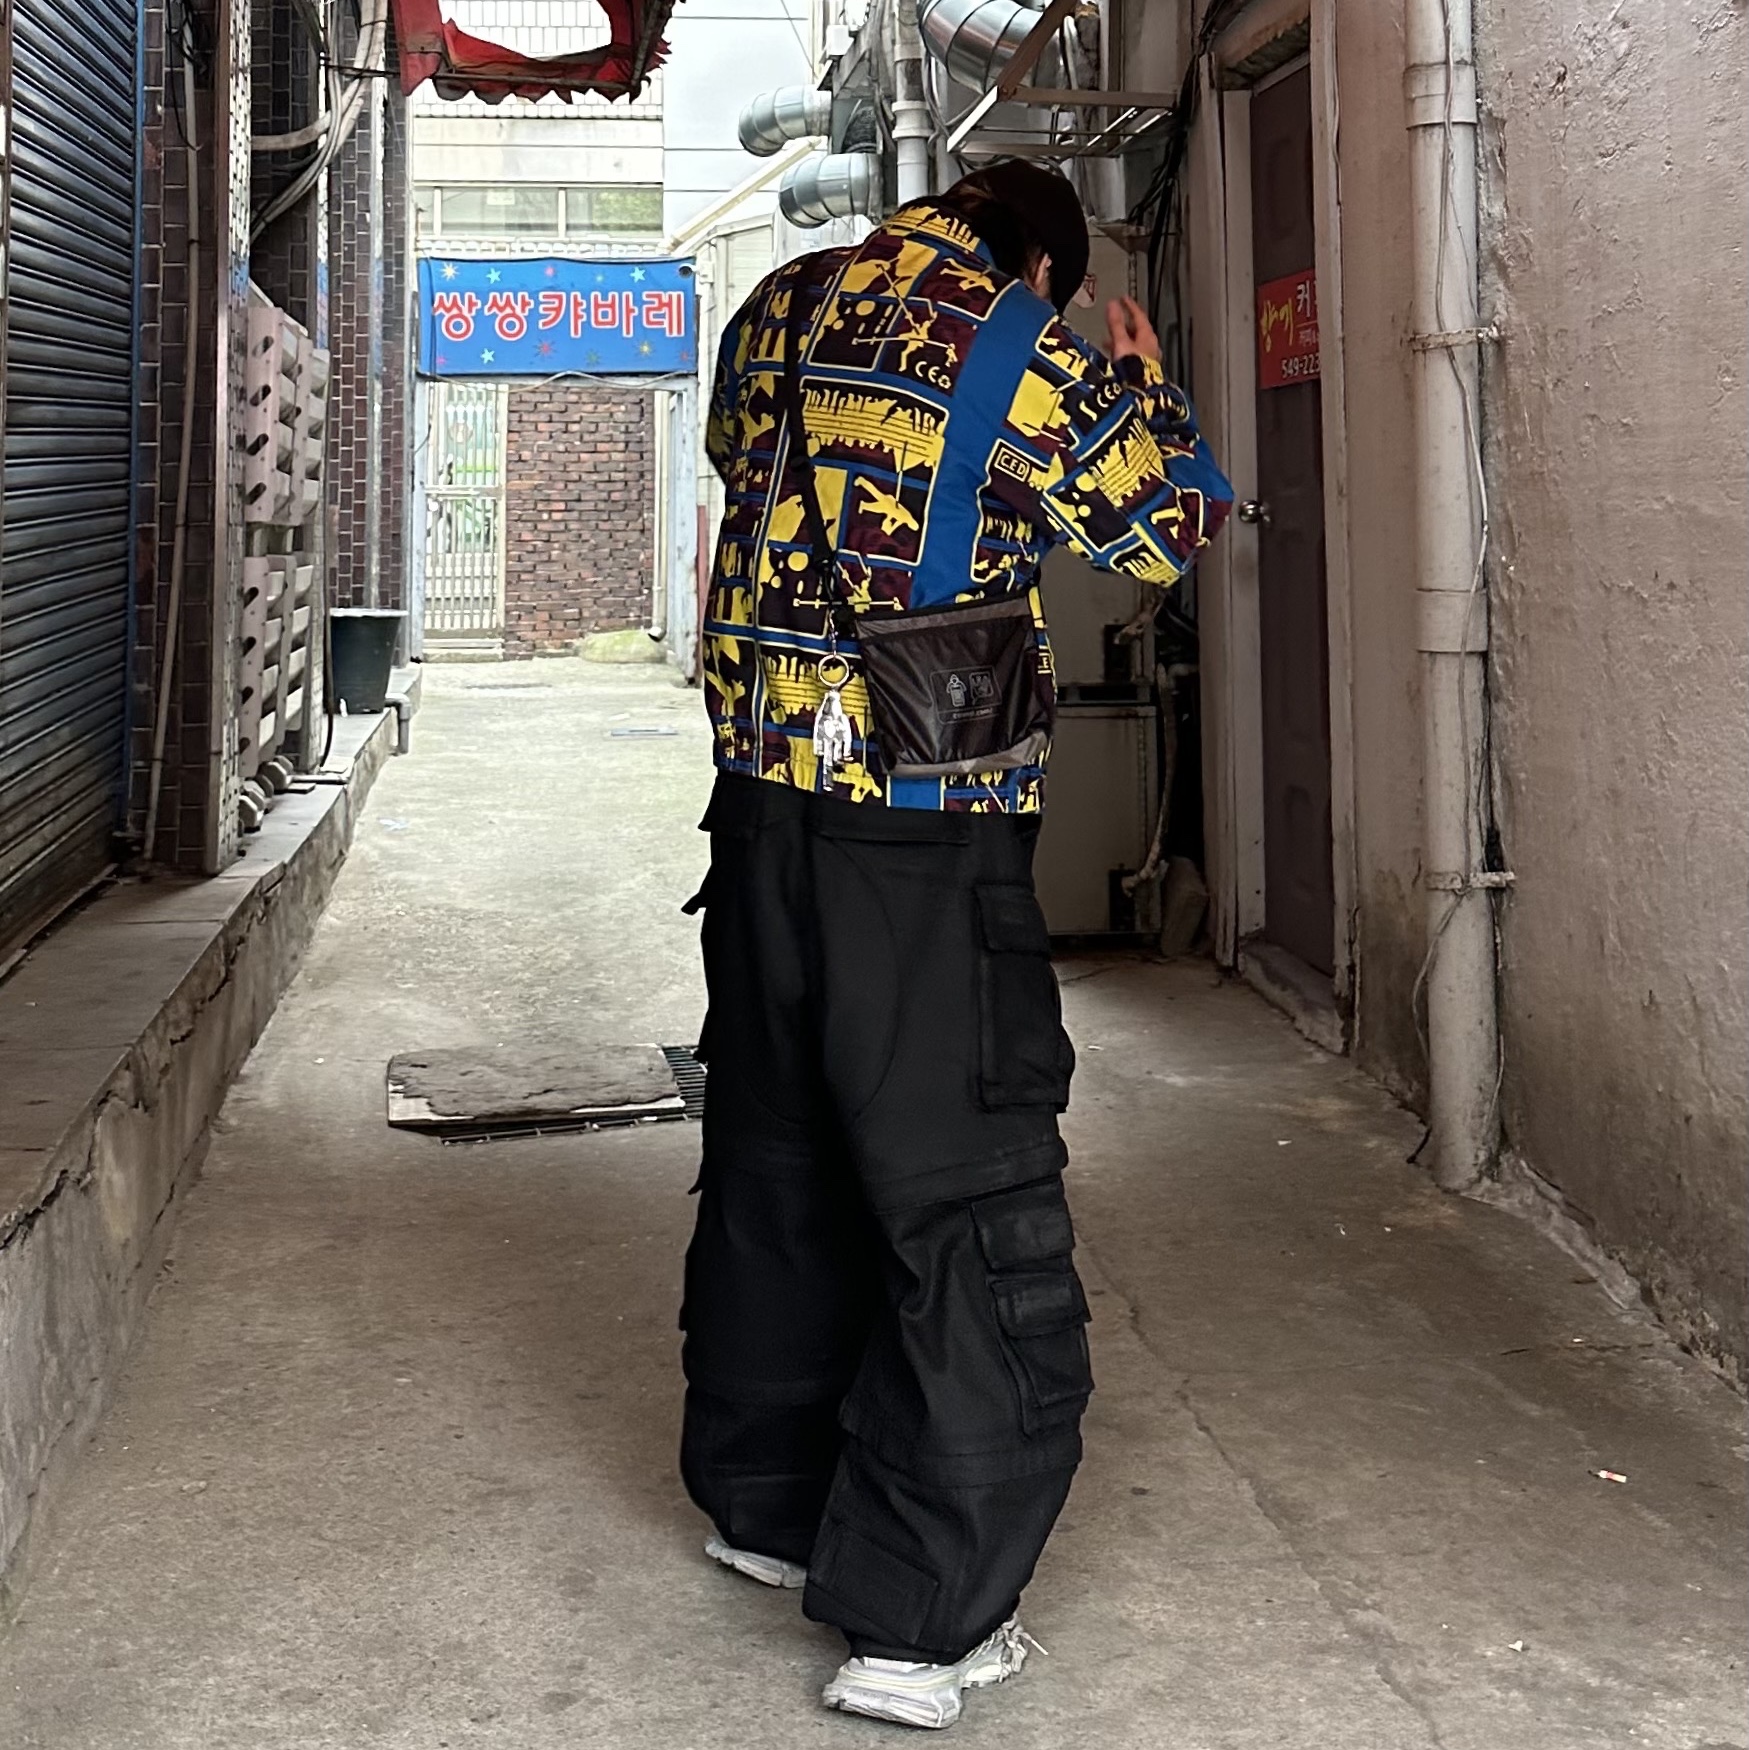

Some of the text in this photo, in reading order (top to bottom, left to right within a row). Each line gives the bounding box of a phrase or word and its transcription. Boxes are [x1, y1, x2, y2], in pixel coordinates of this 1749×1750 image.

[1297, 280, 1317, 318] 커
[433, 291, 685, 341] 쌍쌍캬바레
[1281, 353, 1320, 378] 549-223
[1000, 454, 1026, 475] CED
